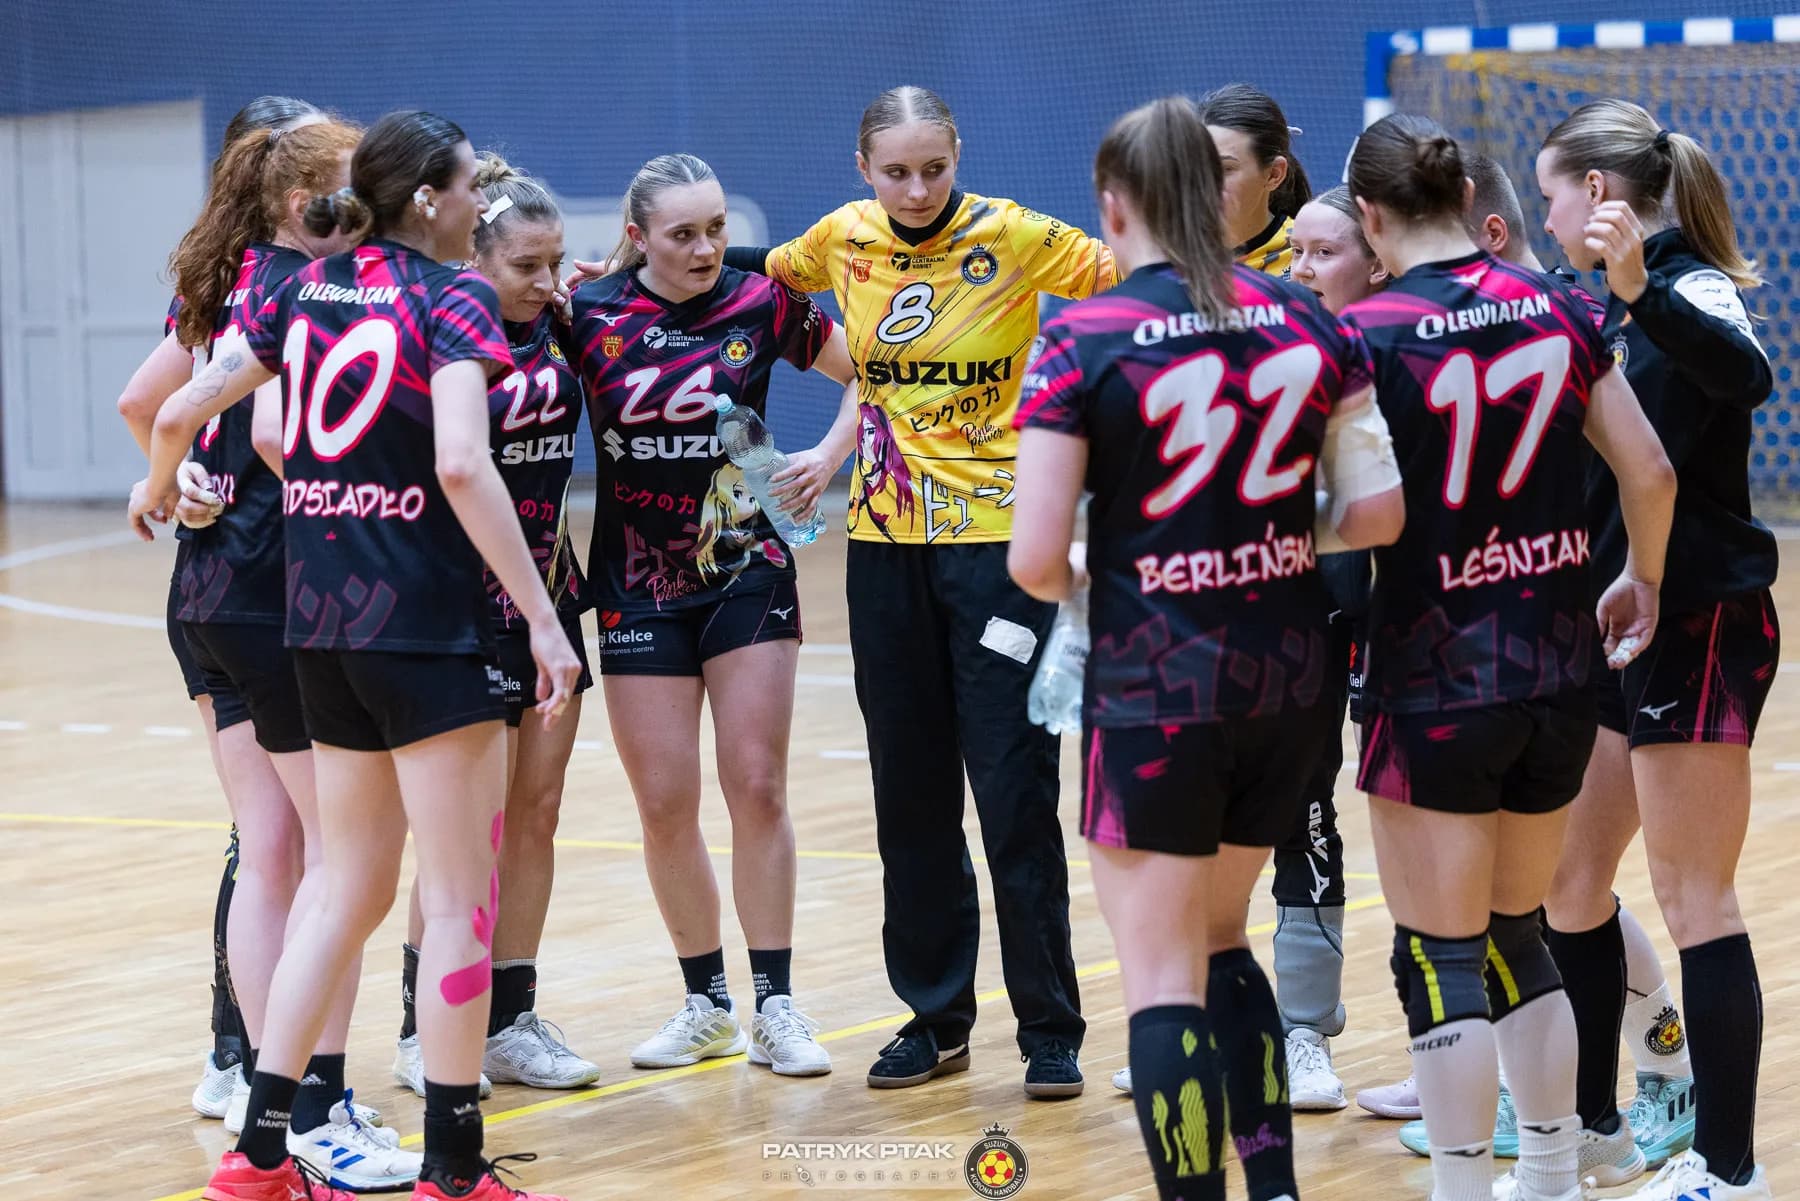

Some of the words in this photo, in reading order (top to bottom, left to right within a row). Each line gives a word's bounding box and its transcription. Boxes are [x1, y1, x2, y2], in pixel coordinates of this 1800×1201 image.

[876, 281, 935, 344] 8
[1447, 294, 1551, 332] LEWIATAN
[604, 344, 620, 357] CK
[865, 356, 1012, 386] SUZUKI
[281, 315, 400, 461] 10
[501, 366, 567, 432] 22
[618, 364, 717, 425] 26
[1139, 341, 1324, 521] 32
[1425, 332, 1572, 509] 17
[1439, 526, 1590, 590] LEŚNIAK
[608, 629, 654, 644] Kielce
